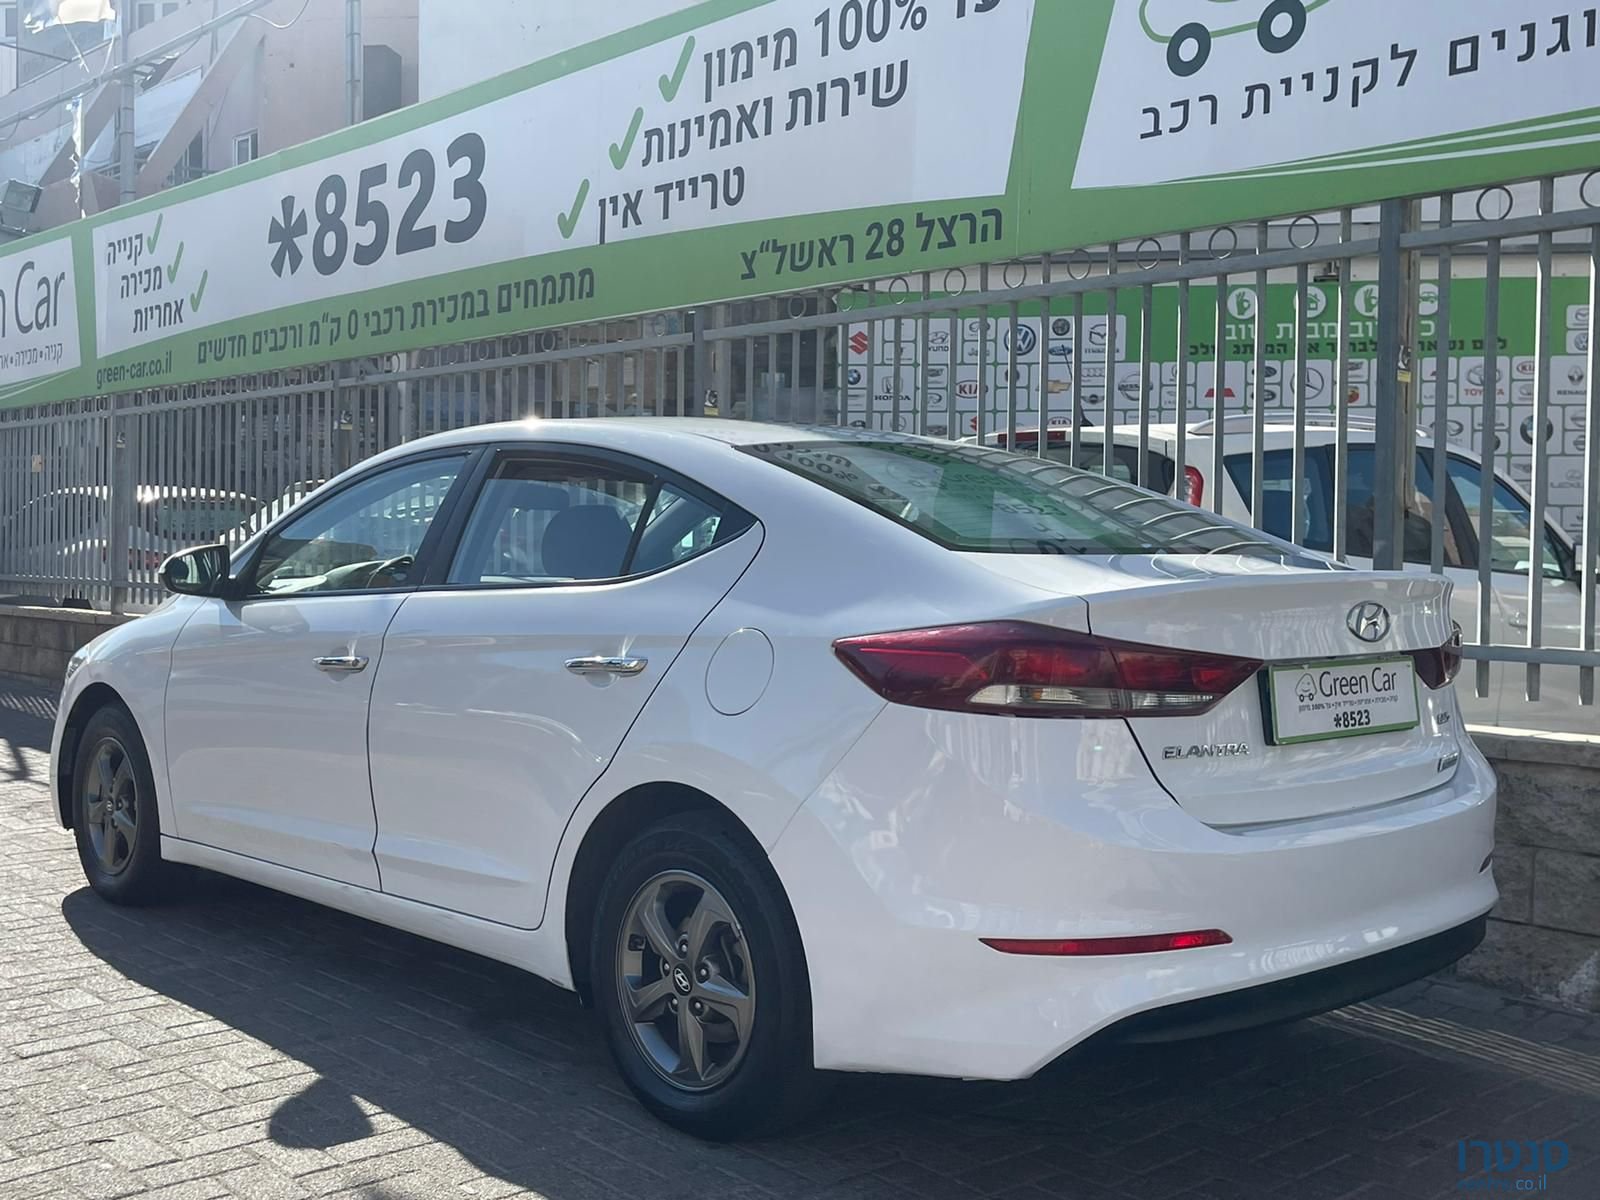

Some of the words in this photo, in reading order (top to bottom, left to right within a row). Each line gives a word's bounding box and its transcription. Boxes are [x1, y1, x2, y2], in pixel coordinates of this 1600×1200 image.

[814, 0, 927, 57] 100%
[1448, 8, 1596, 76] וגנים
[704, 27, 797, 103] מימון
[1241, 43, 1418, 119] לקניית
[785, 59, 909, 131] שירות
[1140, 94, 1218, 139] רכב
[641, 96, 773, 167] ואמינות
[654, 166, 745, 220] טרייד
[598, 189, 643, 245] אין
[915, 208, 1002, 252] הרצל
[107, 233, 143, 266] קנייה
[865, 218, 904, 261] 28
[15, 261, 65, 334] Car
[121, 265, 162, 299] מכירה
[497, 267, 595, 314] מתמחים
[132, 299, 184, 333] אחריות
[347, 308, 358, 340] 0
[363, 305, 405, 337] רכבי
[410, 289, 490, 330] במכירת
[197, 334, 247, 364] חדשים
[252, 323, 304, 355] ורכבים
[97, 351, 172, 389] green-car.co.il
[1319, 671, 1369, 698] Green
[1371, 667, 1397, 692] Car
[1162, 743, 1249, 760] ELANTRA
